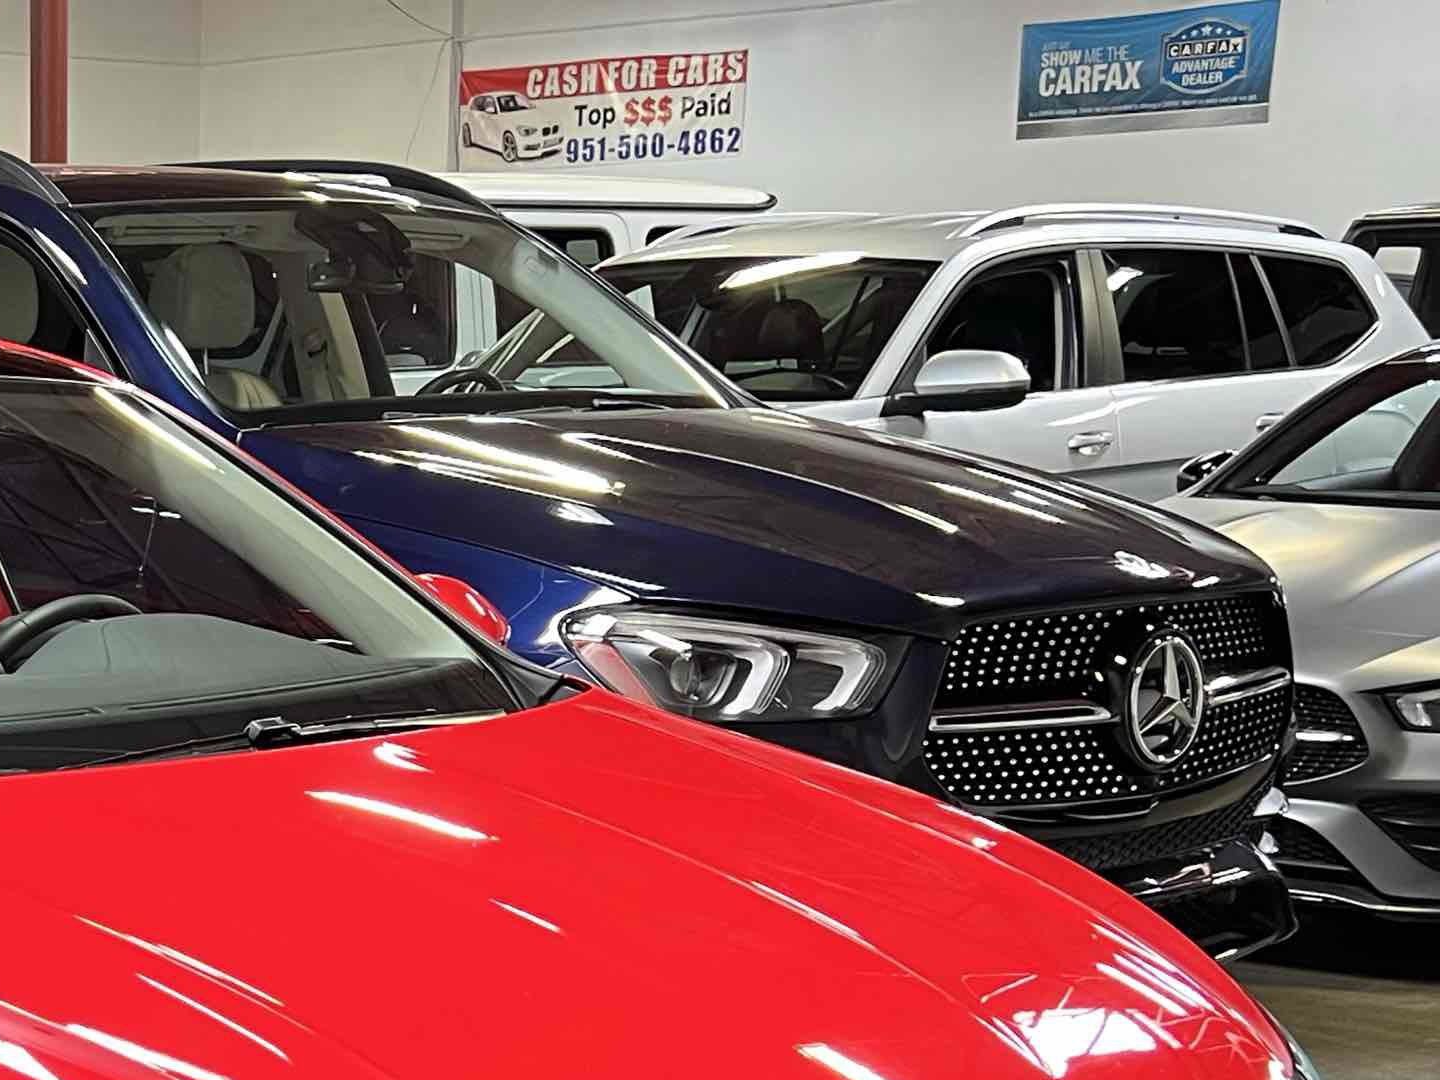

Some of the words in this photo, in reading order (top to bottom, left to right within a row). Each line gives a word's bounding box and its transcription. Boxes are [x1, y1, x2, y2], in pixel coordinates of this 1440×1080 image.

[1040, 49, 1081, 69] SHOW
[1168, 38, 1242, 58] CARFAX
[525, 63, 598, 100] CASH
[607, 57, 657, 92] FOR
[667, 51, 745, 88] CARS
[1038, 60, 1145, 97] CARFAX
[1171, 56, 1237, 75] ADVANTAGE
[1181, 71, 1224, 87] DEALER
[574, 104, 617, 130] Top
[680, 90, 732, 120] Paid
[566, 126, 742, 165] 951-500-4862
